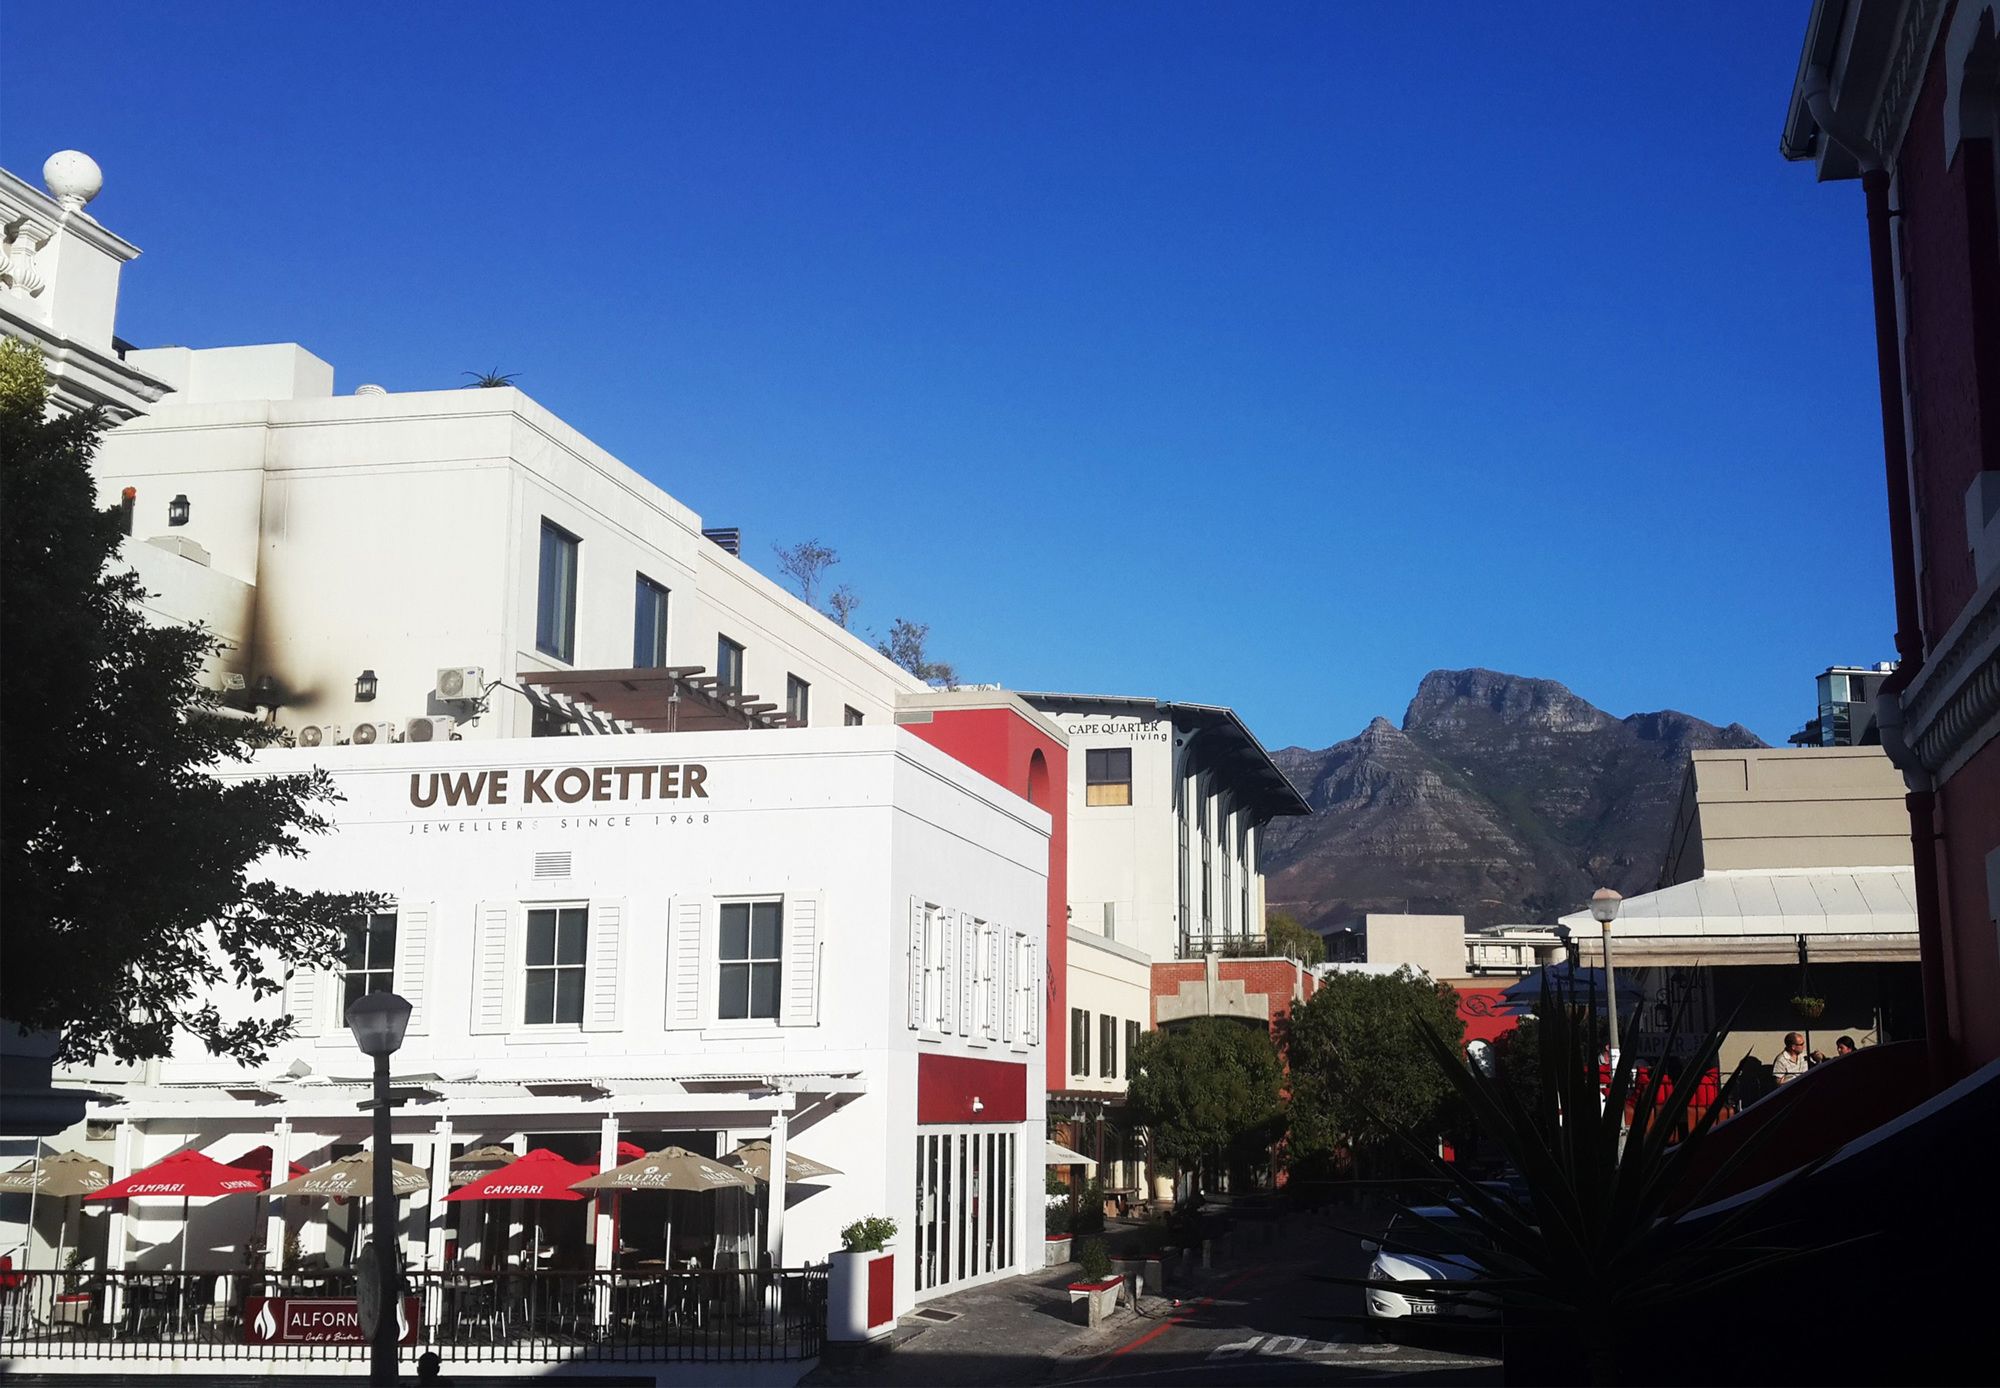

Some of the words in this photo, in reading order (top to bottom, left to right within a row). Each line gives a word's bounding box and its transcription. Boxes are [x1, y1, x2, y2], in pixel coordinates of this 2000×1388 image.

[1068, 724, 1099, 735] CAPE
[1102, 722, 1158, 735] QUARTER
[1131, 733, 1167, 742] living
[410, 770, 508, 808] UWE
[523, 764, 709, 804] KOETTER
[409, 820, 538, 834] JEWELLERS
[561, 816, 631, 828] SINCE
[655, 815, 709, 825] 1968
[126, 1184, 185, 1194] CAMPARI
[483, 1185, 544, 1195] CAMPARI
[291, 1312, 358, 1327] ALFORN
